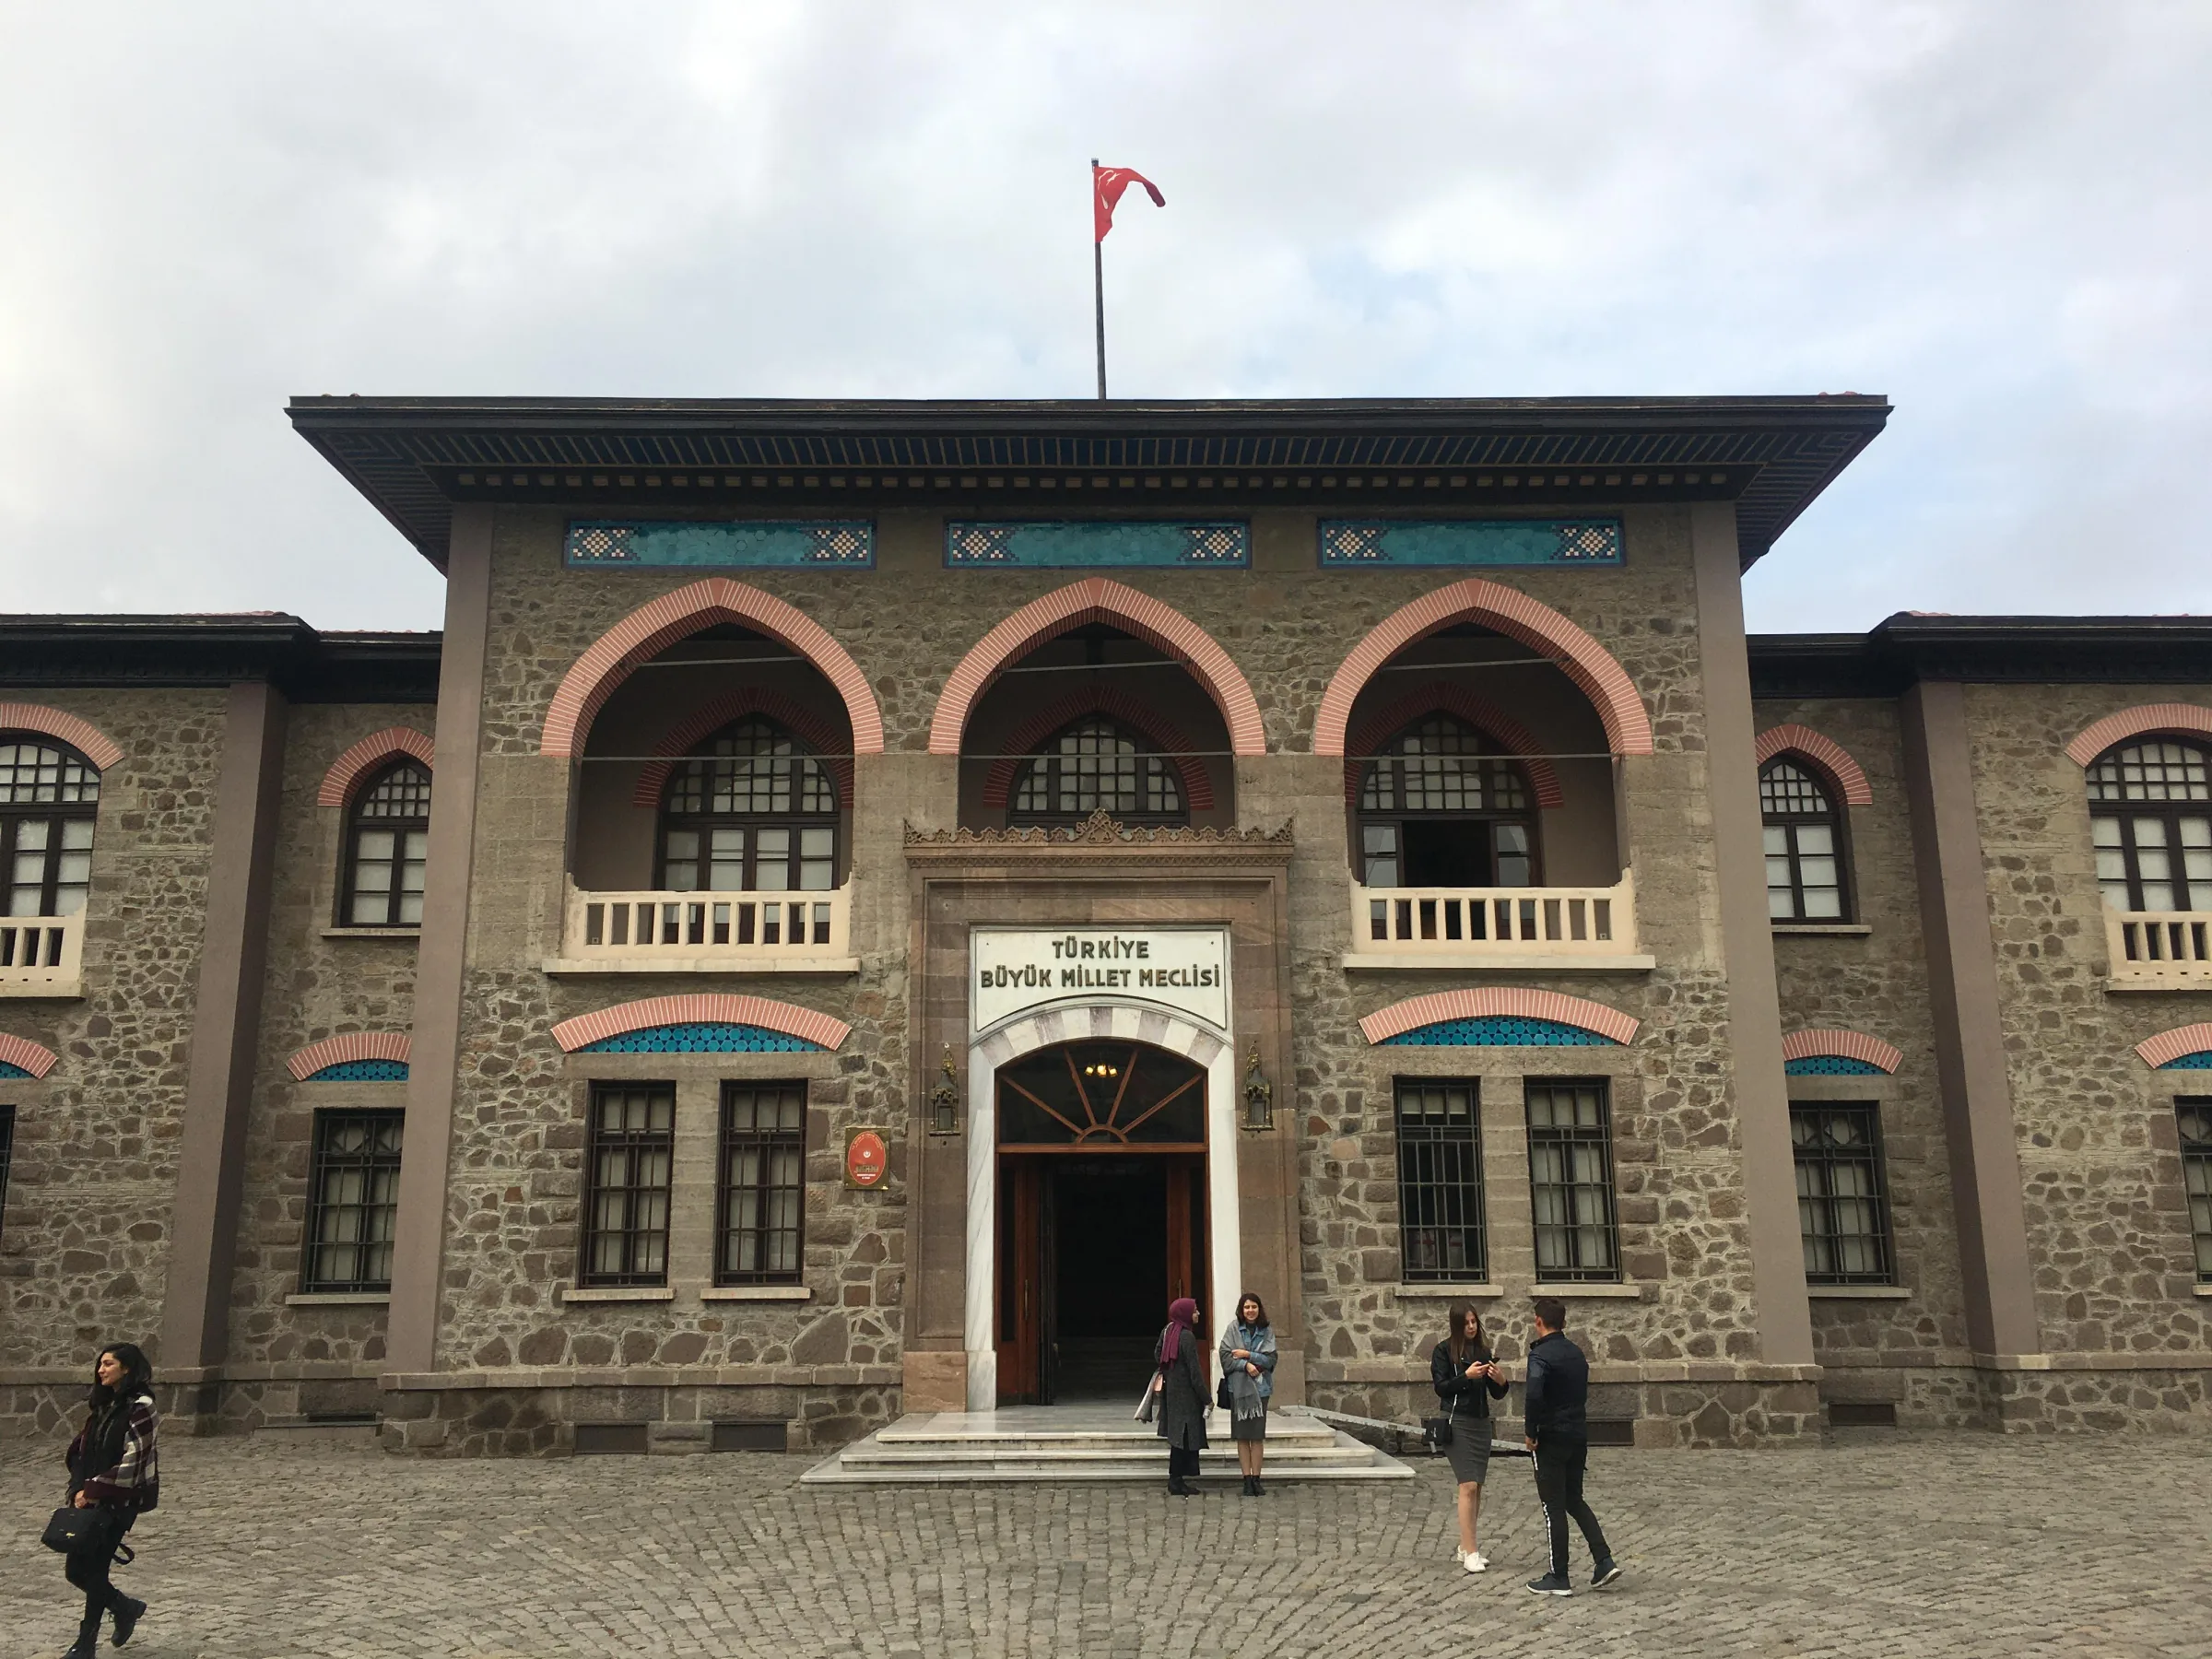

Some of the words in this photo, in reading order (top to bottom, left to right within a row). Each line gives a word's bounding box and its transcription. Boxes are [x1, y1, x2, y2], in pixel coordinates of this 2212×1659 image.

[1052, 935, 1149, 959] TÜRKİYE
[981, 964, 1052, 988] BÜYÜK
[1061, 964, 1131, 987] MİLLET
[1138, 964, 1220, 987] MECLİSİ
